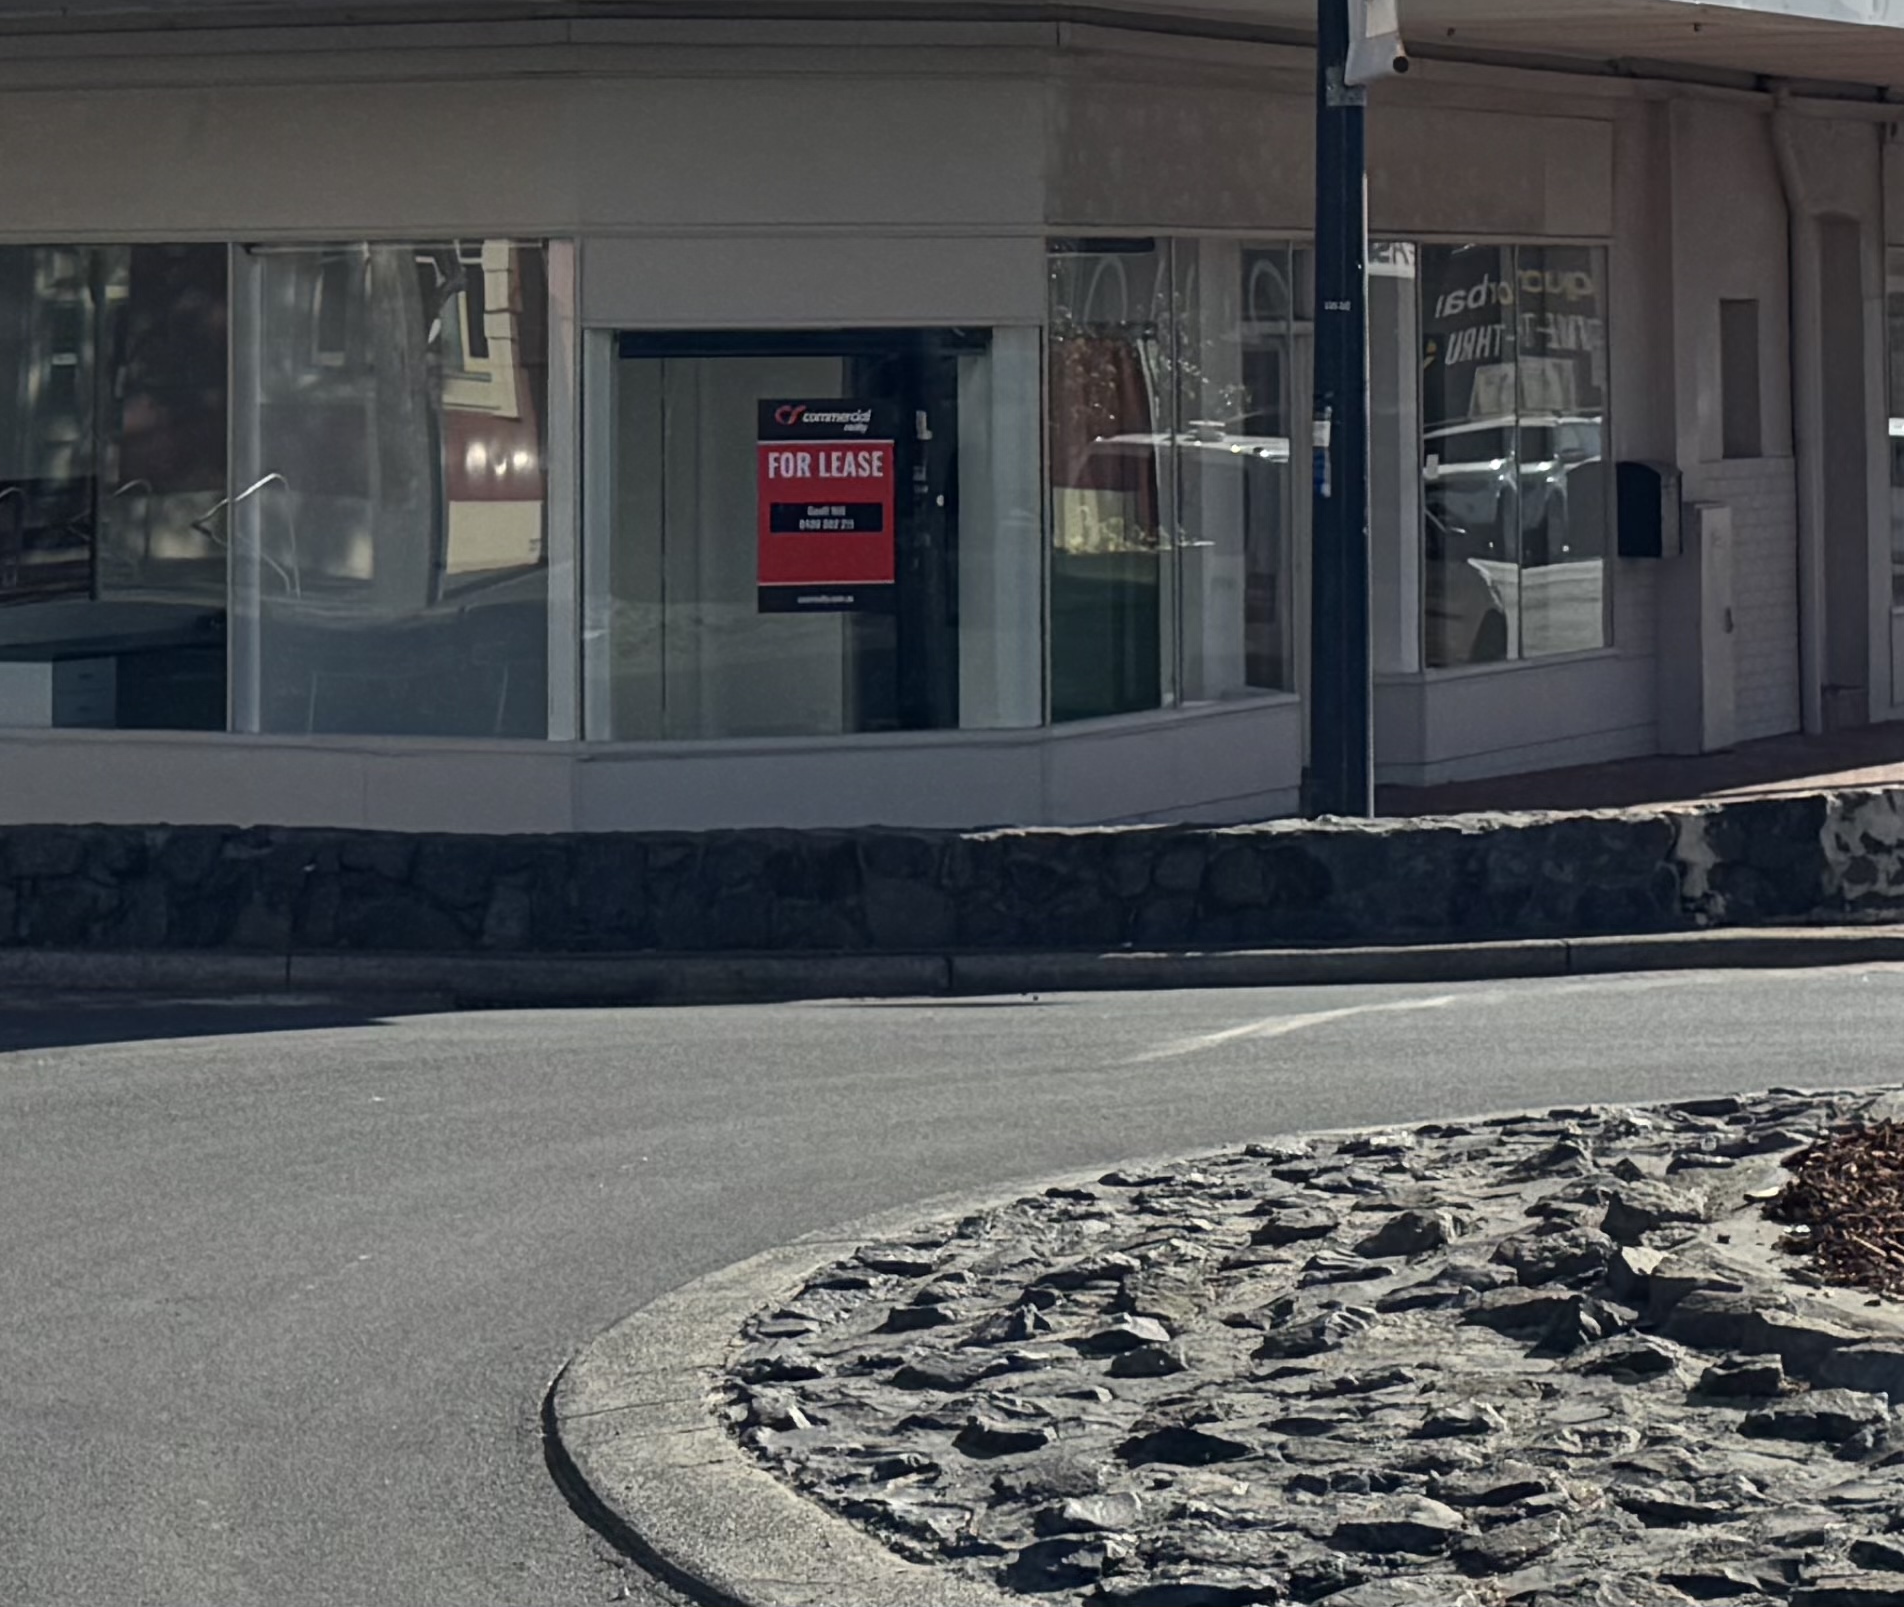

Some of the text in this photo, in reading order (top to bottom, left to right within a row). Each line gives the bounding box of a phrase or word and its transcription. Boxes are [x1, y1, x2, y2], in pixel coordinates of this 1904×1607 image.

[802, 408, 872, 424] commercial
[768, 450, 884, 479] FOR LEASE
